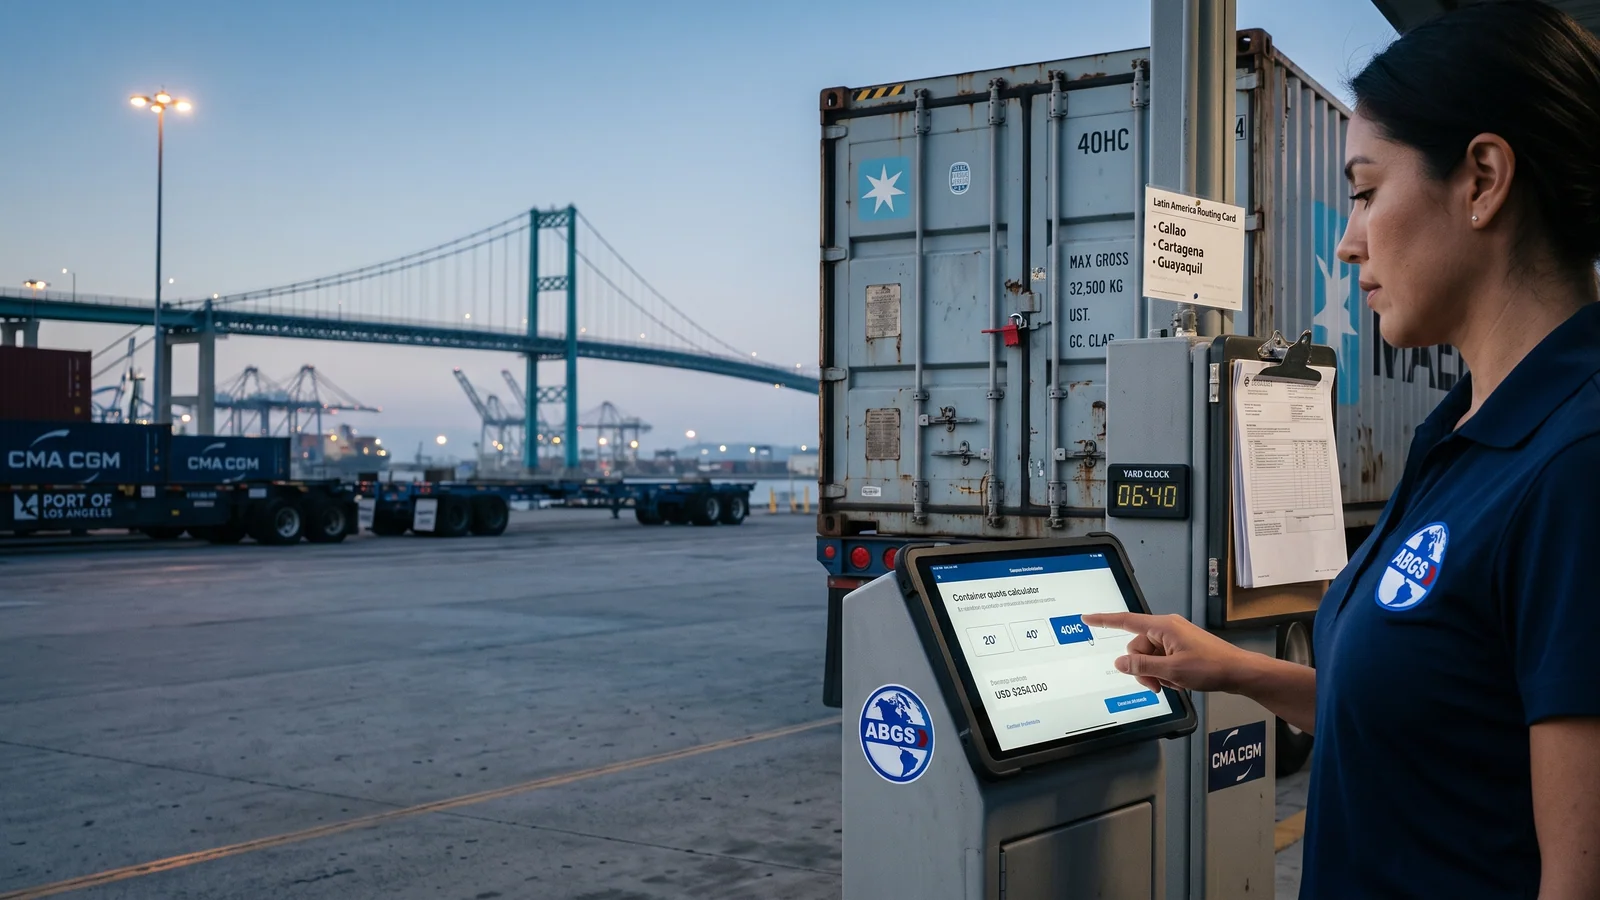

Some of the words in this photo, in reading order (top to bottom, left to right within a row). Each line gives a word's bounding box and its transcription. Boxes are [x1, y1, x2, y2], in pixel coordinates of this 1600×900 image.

[1078, 128, 1129, 154] 40HC
[1153, 197, 1170, 209] Latin
[1171, 201, 1197, 215] America
[1197, 206, 1221, 222] Routing
[1222, 212, 1237, 223] Card
[1158, 221, 1187, 237] Callao
[1158, 239, 1204, 258] Cartagena
[1070, 254, 1091, 269] MAX
[1095, 252, 1129, 267] GROSS
[1157, 256, 1203, 276] Guayaquil
[1070, 280, 1105, 296] 32,500
[1109, 279, 1123, 293] KG
[1069, 307, 1090, 322] UST.
[1069, 334, 1085, 348] GC.
[8, 450, 64, 469] CMA
[69, 451, 120, 469] CGM
[187, 456, 222, 470] CMA
[224, 457, 259, 470] CGM
[1123, 470, 1143, 478] YARD
[1144, 470, 1170, 478] CLOCK
[43, 493, 86, 508] PORT
[91, 493, 112, 508] OF
[1118, 485, 1177, 508] 06:40
[43, 508, 63, 519] LOS
[66, 508, 112, 519] ANGELES
[1392, 548, 1429, 579] ABGS
[952, 592, 987, 602] Container
[1008, 586, 1040, 597] calculator
[1026, 629, 1039, 640] 40'
[1060, 624, 1084, 635] 40HC
[983, 635, 997, 645] 20'
[995, 689, 1011, 699] USD
[865, 722, 916, 744] ABGS
[1212, 749, 1236, 769] CMA
[1238, 742, 1262, 762] CGM
